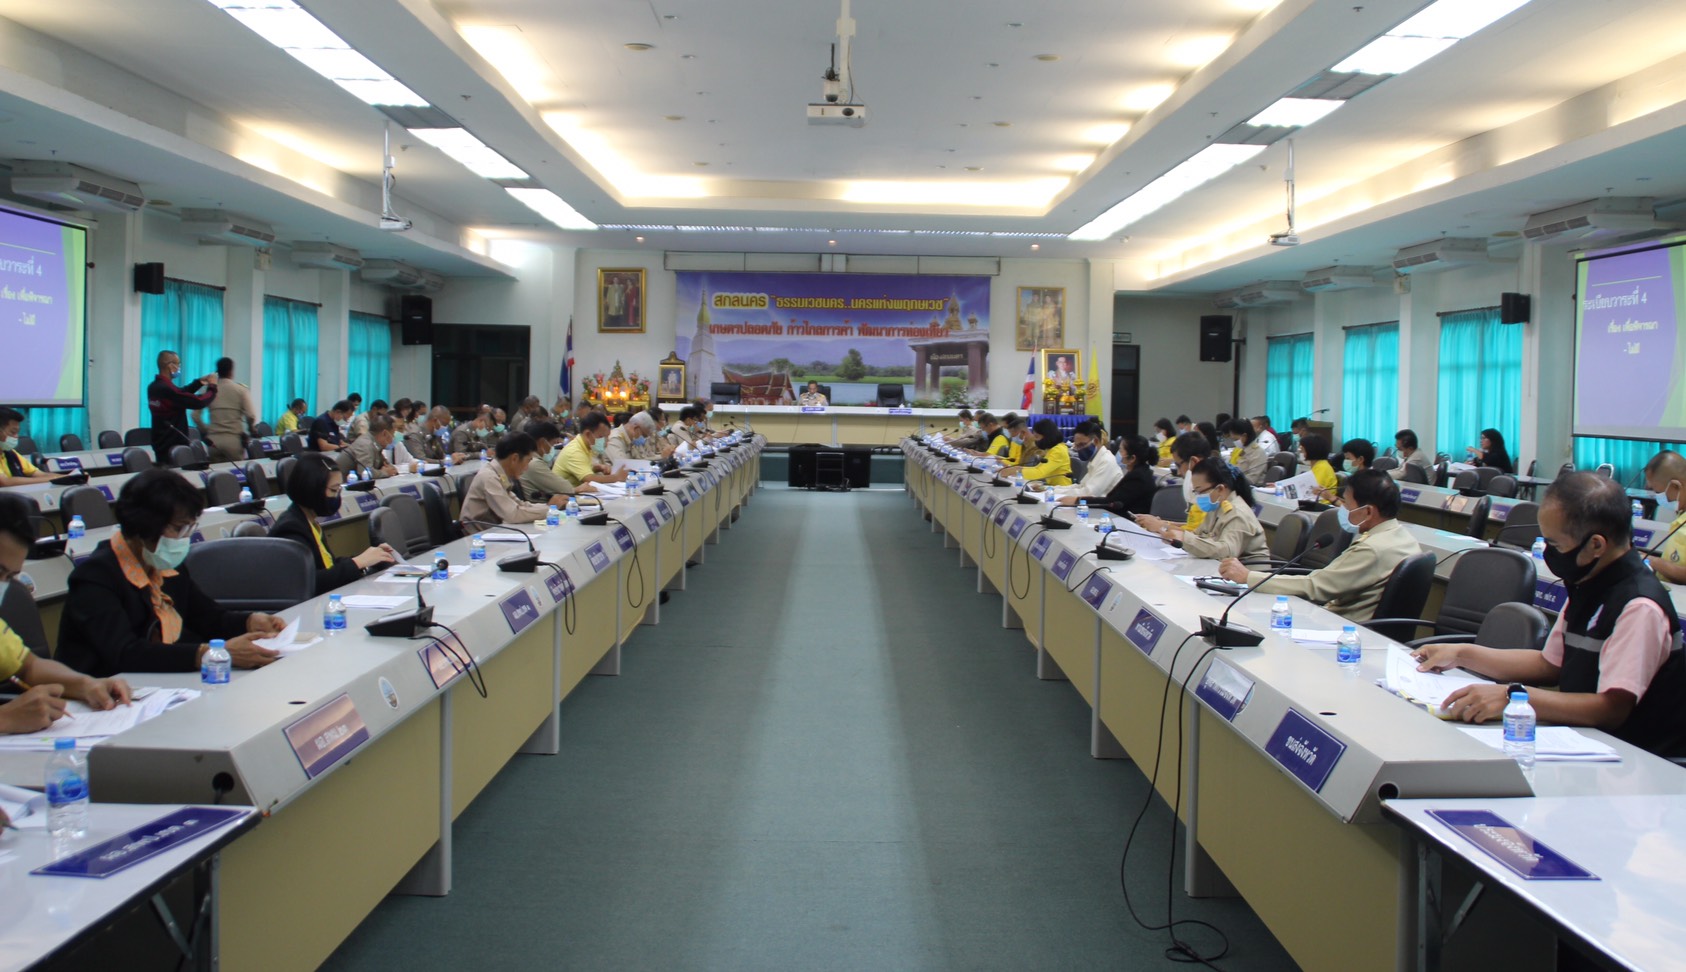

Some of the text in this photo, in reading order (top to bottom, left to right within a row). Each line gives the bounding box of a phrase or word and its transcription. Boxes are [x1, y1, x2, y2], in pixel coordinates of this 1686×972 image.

[36, 264, 42, 276] 4
[714, 293, 767, 308] สกลนคร
[1641, 292, 1647, 303] 4
[1285, 735, 1319, 766] ขนส่งจังหวัด
